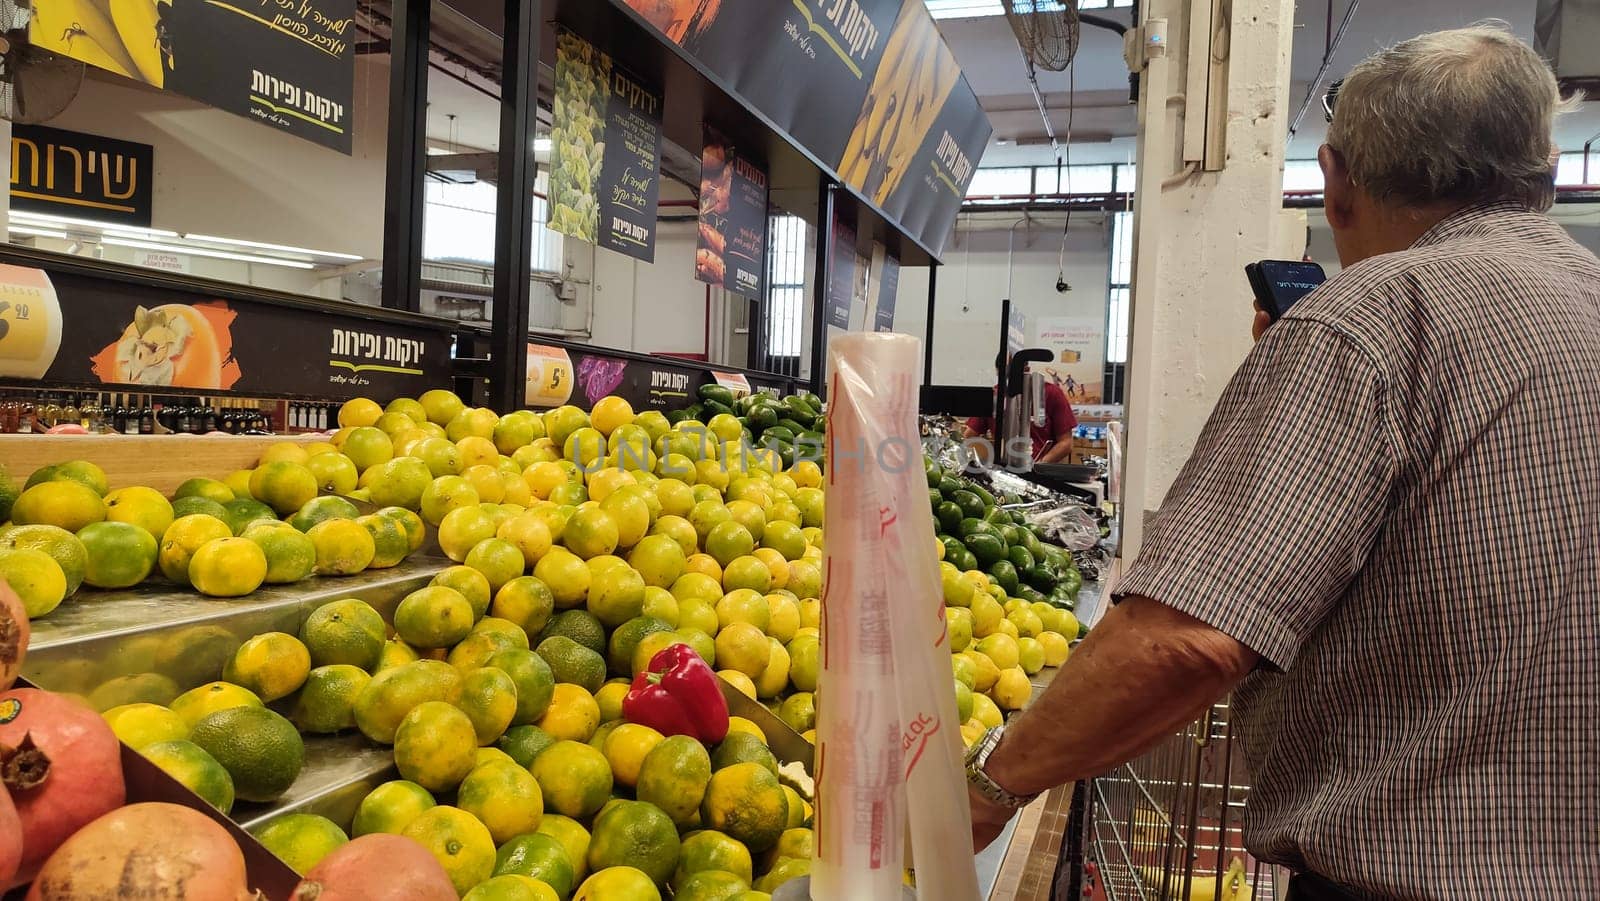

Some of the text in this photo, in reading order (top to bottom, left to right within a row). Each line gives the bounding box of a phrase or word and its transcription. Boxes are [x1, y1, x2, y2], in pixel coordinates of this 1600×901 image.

[271, 13, 346, 54] מערכת החיסון
[314, 11, 352, 35] לשמירה
[251, 69, 343, 123] ירקות ופירות
[615, 72, 657, 115] ירוקים
[10, 136, 137, 199] שירות
[936, 130, 972, 186] ירקות ופירות
[612, 216, 649, 242] ירקות ופירות
[331, 328, 425, 367] ירקות ופירות
[651, 370, 689, 392] ירקות ופירות
